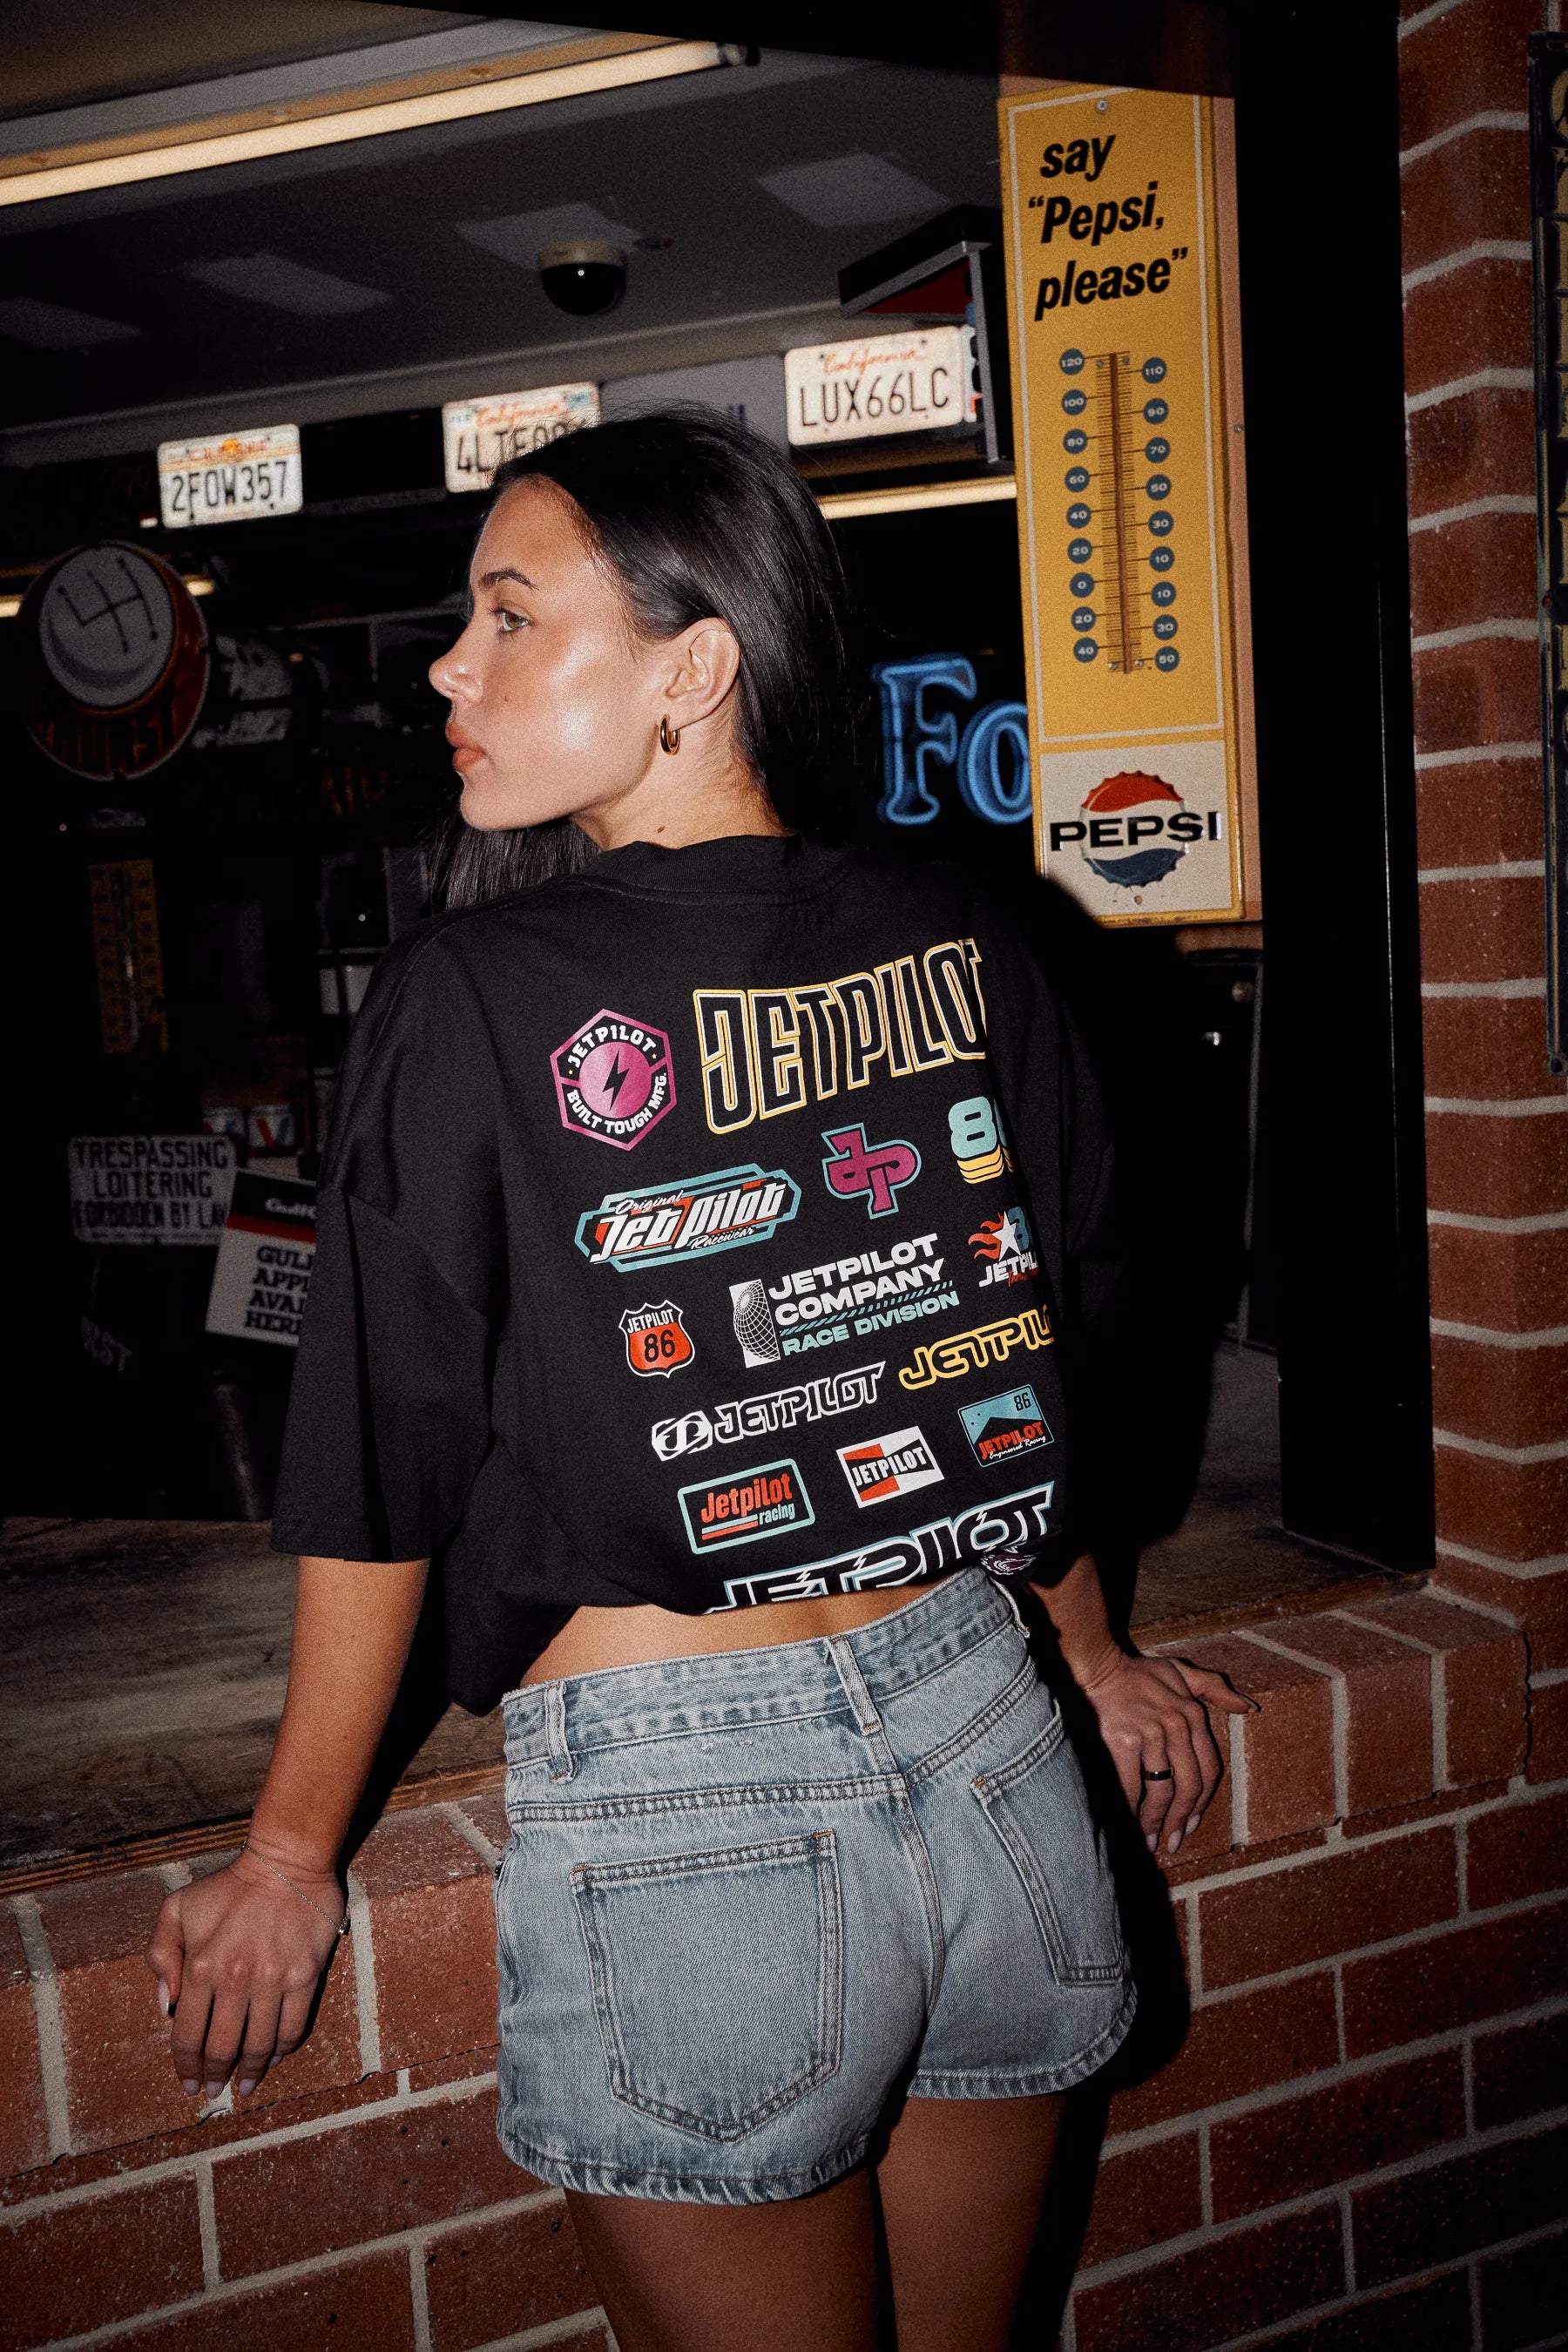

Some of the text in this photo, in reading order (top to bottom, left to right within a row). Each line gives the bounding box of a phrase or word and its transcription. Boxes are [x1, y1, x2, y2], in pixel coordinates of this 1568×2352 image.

[1039, 135, 1117, 182] say
[1061, 357, 1083, 368] 120
[1146, 366, 1164, 375] 110
[800, 368, 949, 427] LUX66LC
[1064, 397, 1085, 407] 100
[1148, 407, 1165, 416] 90
[1150, 445, 1166, 455] 70
[1151, 483, 1167, 492] 50
[1070, 510, 1087, 520] 40
[1152, 519, 1169, 529] 30
[1072, 546, 1089, 555] 20
[1155, 554, 1169, 564] 10
[1078, 581, 1086, 590] 0
[1157, 589, 1171, 598] 10
[1075, 614, 1092, 624] 20
[1157, 622, 1174, 632] 30
[1078, 645, 1094, 655] 40
[1159, 654, 1175, 664] 50
[1050, 810, 1221, 852] PEPSI
[567, 1024, 657, 1069] JETPILOT
[566, 1072, 668, 1134] BUILT TOUGH MFG.
[74, 1139, 227, 1169] TRESPASSING
[93, 1172, 213, 1199] LOITERING
[74, 1200, 165, 1229] FORBIDDEN
[170, 1201, 191, 1228] BY
[614, 1189, 685, 1217] Original
[688, 1225, 757, 1251] Racewear
[767, 1233, 940, 1301] JETPILOT
[774, 1257, 945, 1326] COMPANY
[626, 1308, 674, 1334] JETPILOT
[781, 1290, 960, 1356] RACE DIVISION
[644, 1328, 676, 1362] 86
[713, 1361, 887, 1444] JETPILOT
[1013, 1392, 1031, 1411] 86
[978, 1421, 1044, 1461] JETPILOT
[989, 1435, 1047, 1460] Engineered Racing
[851, 1446, 928, 1487] JETPILOT
[700, 1472, 794, 1524] Jetpilot
[758, 1502, 795, 1526] racing
